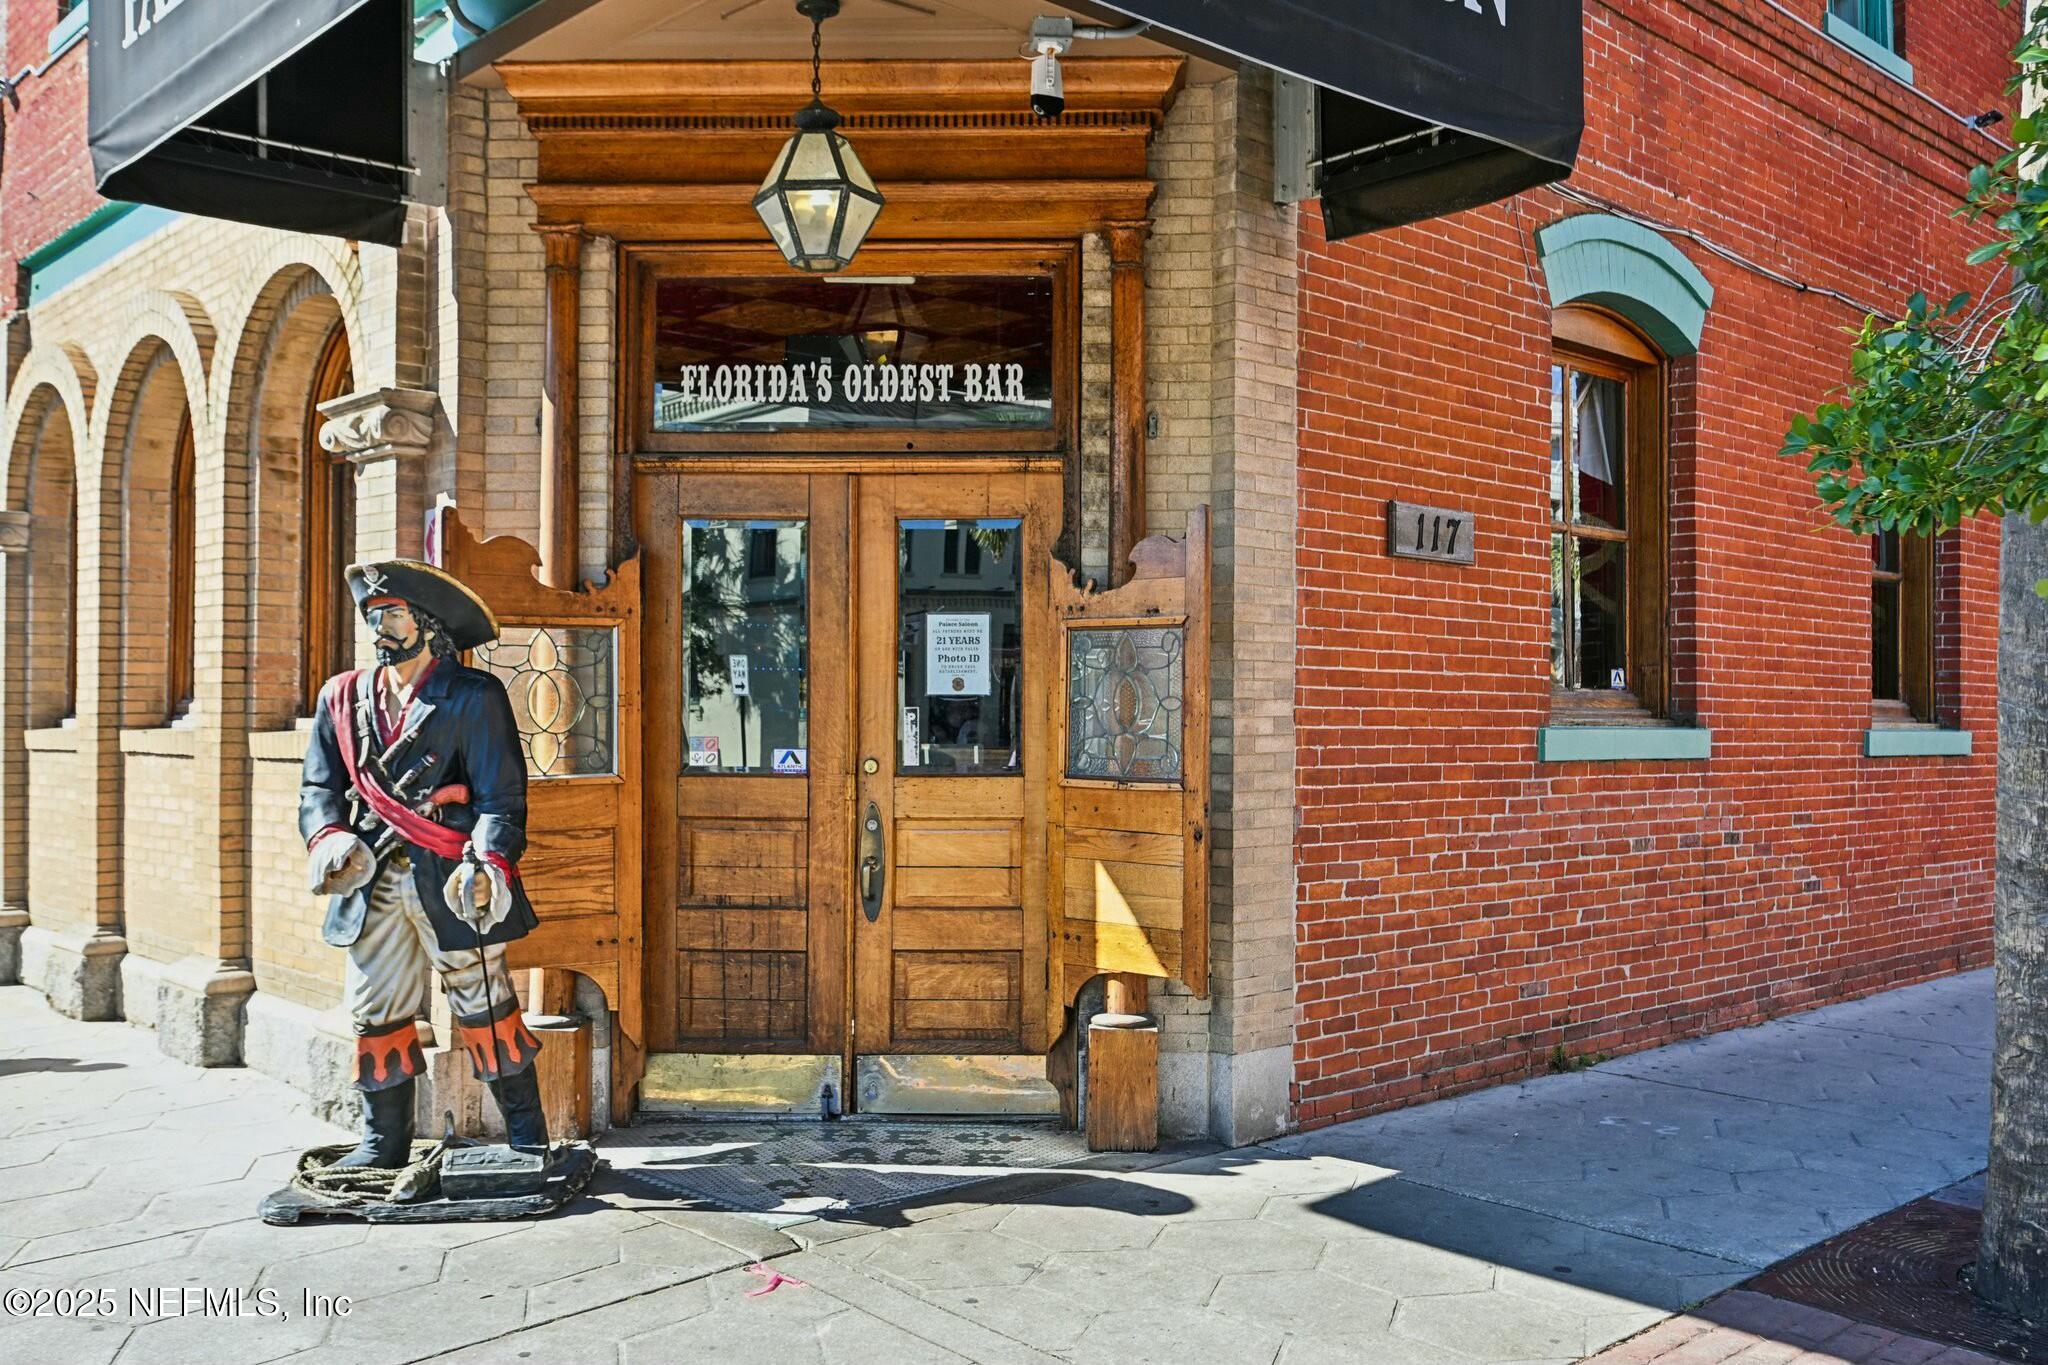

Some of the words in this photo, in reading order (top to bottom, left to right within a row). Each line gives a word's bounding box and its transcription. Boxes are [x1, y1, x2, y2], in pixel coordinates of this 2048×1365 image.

[680, 361, 832, 403] FLORIDA'S
[842, 363, 954, 403] OLDEST
[963, 363, 1026, 403] BAR
[1416, 512, 1462, 555] 117
[936, 636, 946, 645] 21
[949, 636, 981, 645] YEARS
[937, 654, 967, 663] Photo
[969, 654, 980, 663] ID
